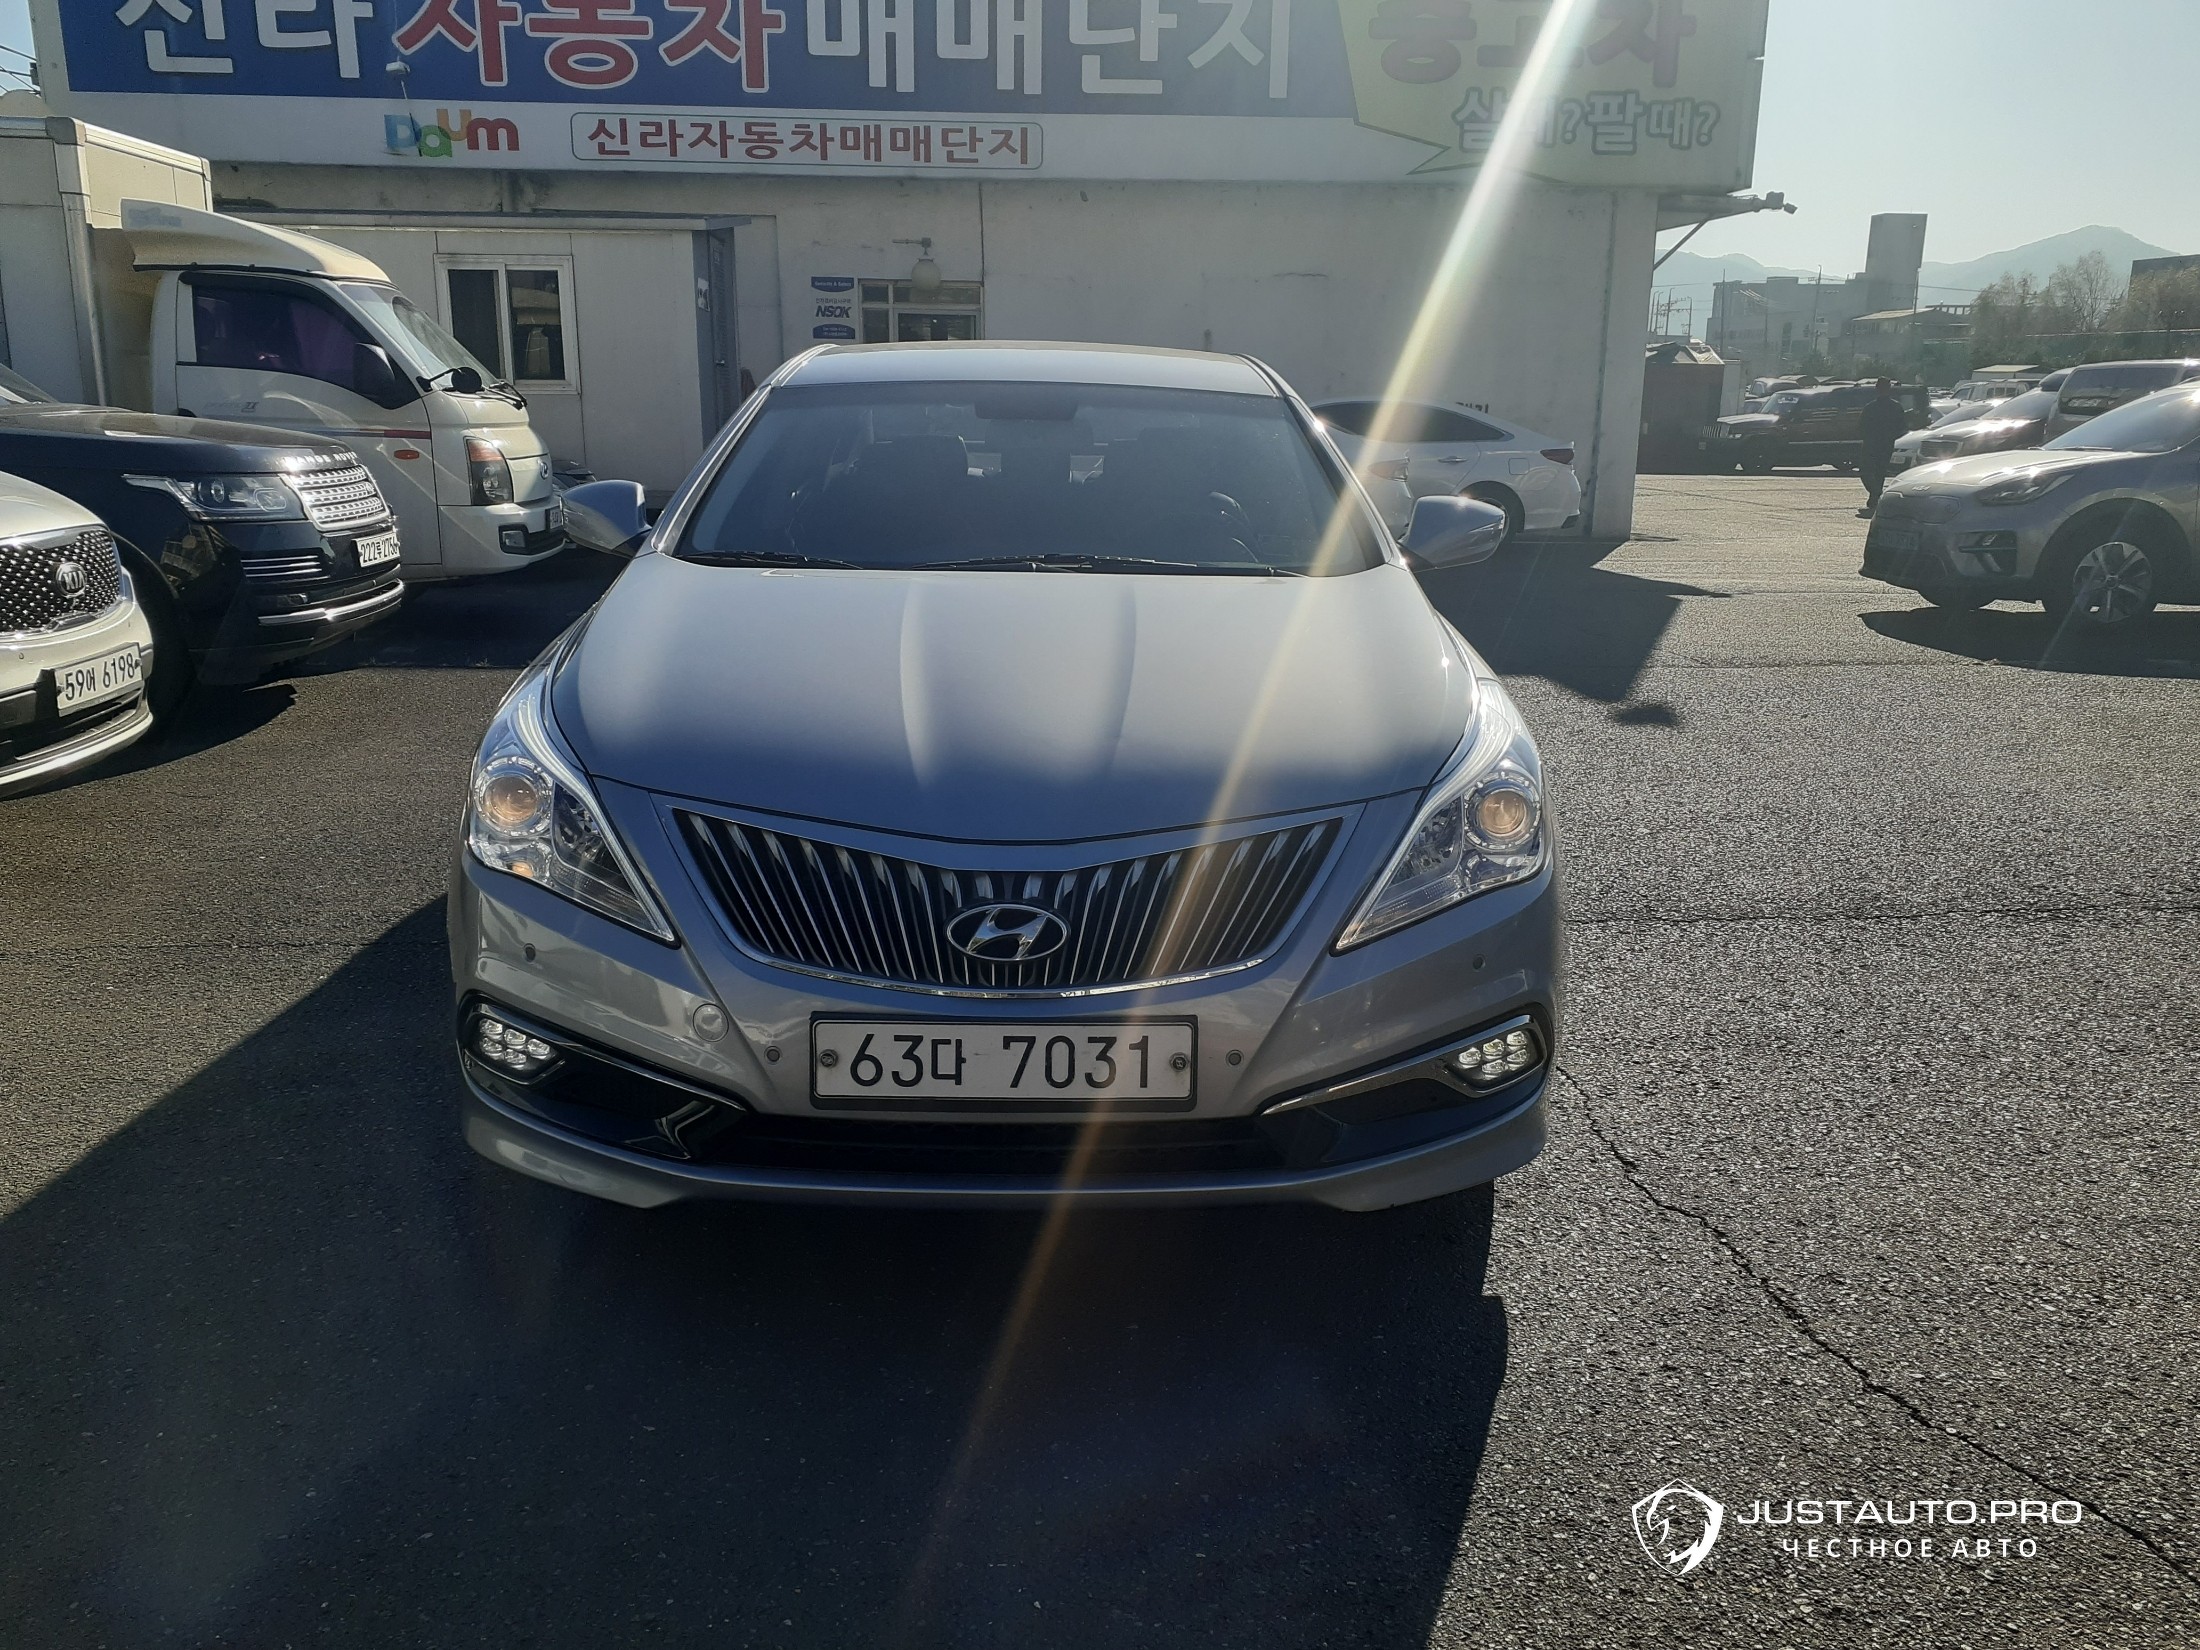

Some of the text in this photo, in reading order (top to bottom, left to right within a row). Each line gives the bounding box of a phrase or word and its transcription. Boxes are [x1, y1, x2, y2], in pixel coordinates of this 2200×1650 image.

[587, 117, 1029, 165] 신라자동차매매단지
[815, 305, 852, 319] NSOK
[63, 570, 84, 590] KIA
[64, 652, 135, 701] 59어 6198
[849, 1033, 1149, 1089] 63다 7031
